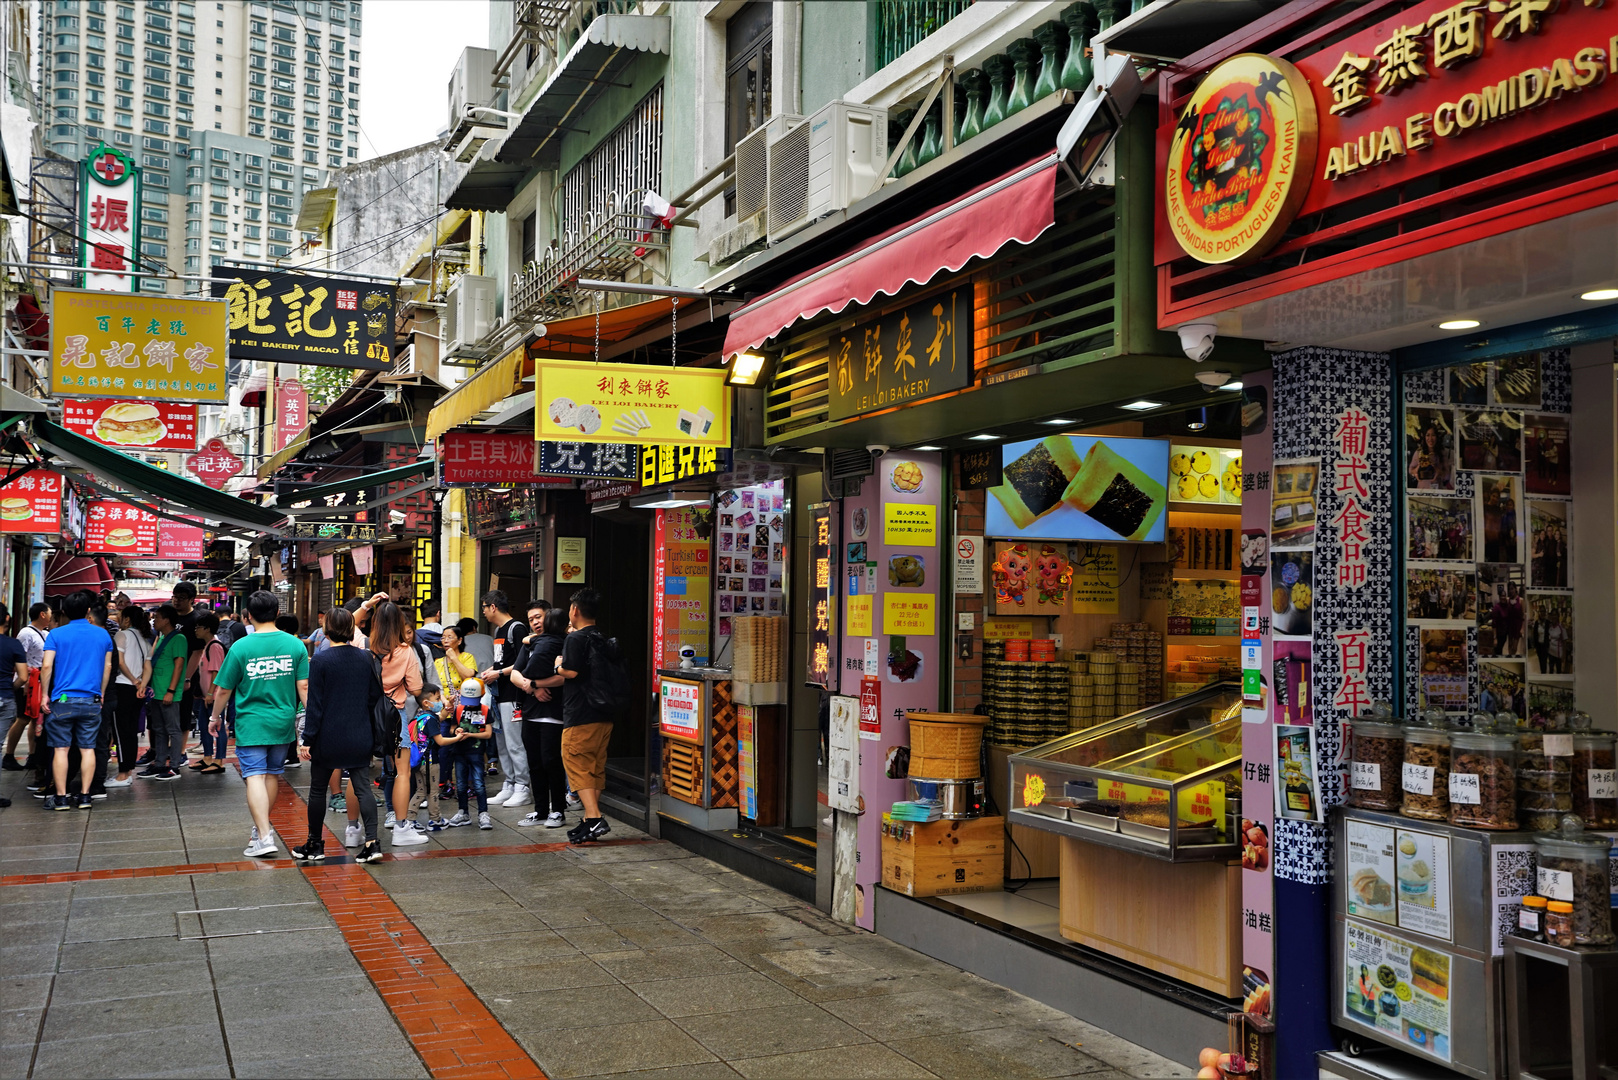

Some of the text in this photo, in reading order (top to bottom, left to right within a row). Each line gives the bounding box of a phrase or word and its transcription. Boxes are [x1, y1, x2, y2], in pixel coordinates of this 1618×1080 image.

[1323, 124, 1405, 182] ALUA
[1406, 111, 1433, 150] E
[1434, 47, 1607, 138] COMIDAS
[1177, 217, 1213, 254] COMIDAS
[1216, 180, 1285, 254] PORTUGUESA
[1280, 119, 1294, 175] KAMIN
[69, 298, 212, 315] PASTELARIA FONG KEI
[95, 315, 188, 336] 百年老號
[241, 339, 257, 347] KEI
[262, 342, 300, 351] BAKERY
[305, 346, 339, 354] MACAO
[343, 321, 360, 355] 手信
[60, 334, 219, 375] 晃記餅家
[597, 376, 671, 399] 利來餅家
[856, 378, 930, 411] LEI LOI BAKERY
[591, 399, 609, 407] LEI
[635, 401, 679, 410] BAKERY
[448, 439, 534, 464] 土耳其冰
[452, 469, 502, 478] TURKISH
[1333, 410, 1370, 586] 葡式食品
[668, 548, 696, 561] Turkish
[672, 562, 708, 576] Ice cream
[246, 659, 293, 677] SCENE
